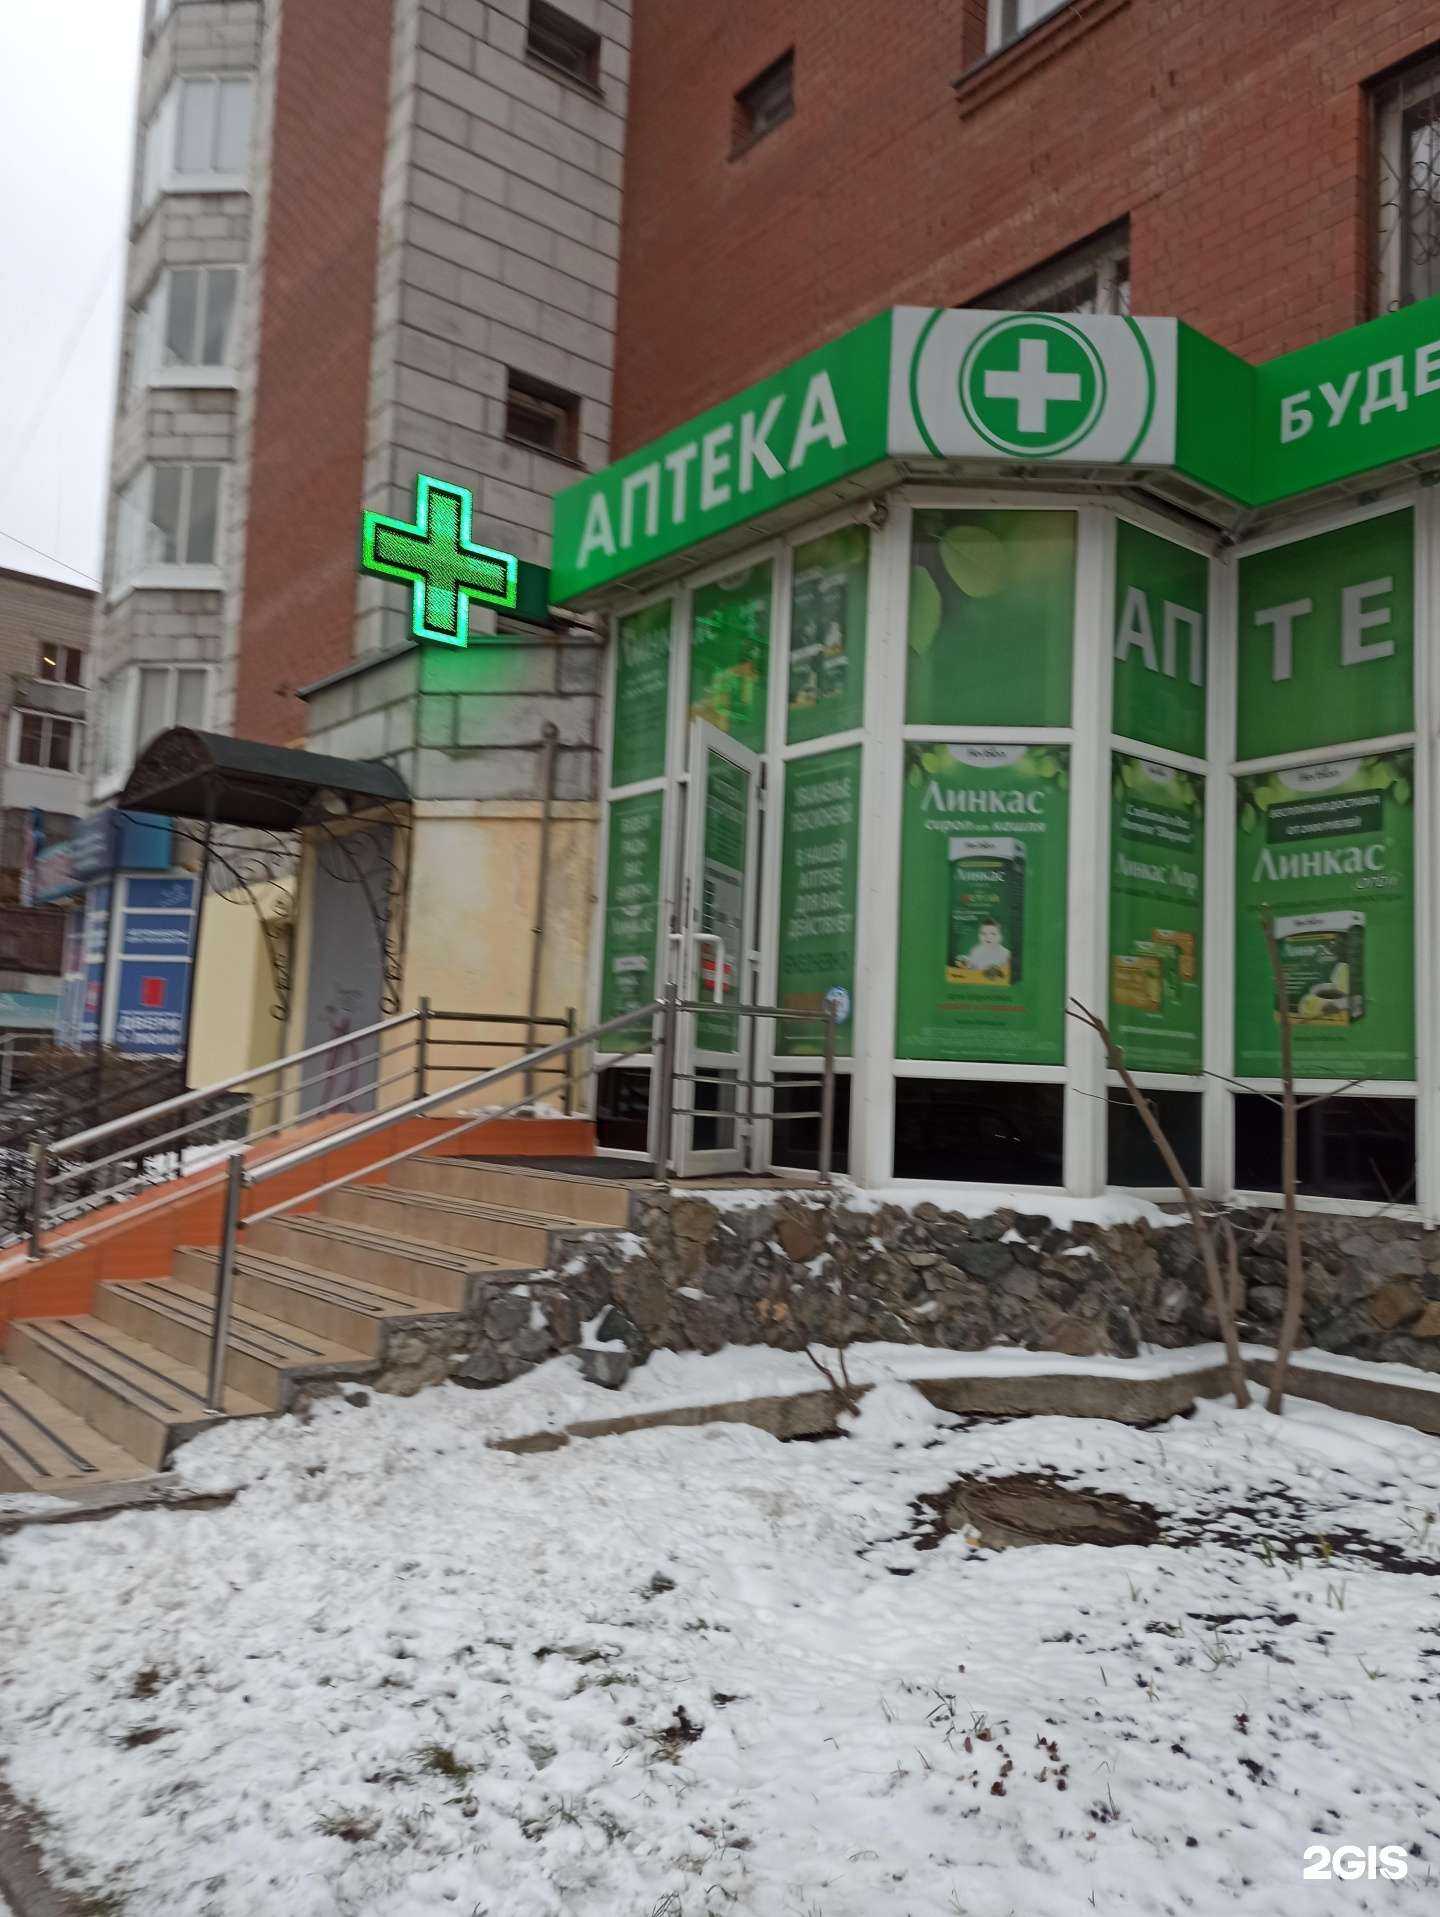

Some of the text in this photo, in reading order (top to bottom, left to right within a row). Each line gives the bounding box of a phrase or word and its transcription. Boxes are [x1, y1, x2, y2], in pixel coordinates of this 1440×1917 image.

[576, 370, 847, 569] АПТЕКА
[920, 780, 1045, 814] Линкас
[1252, 844, 1386, 882] Линкас
